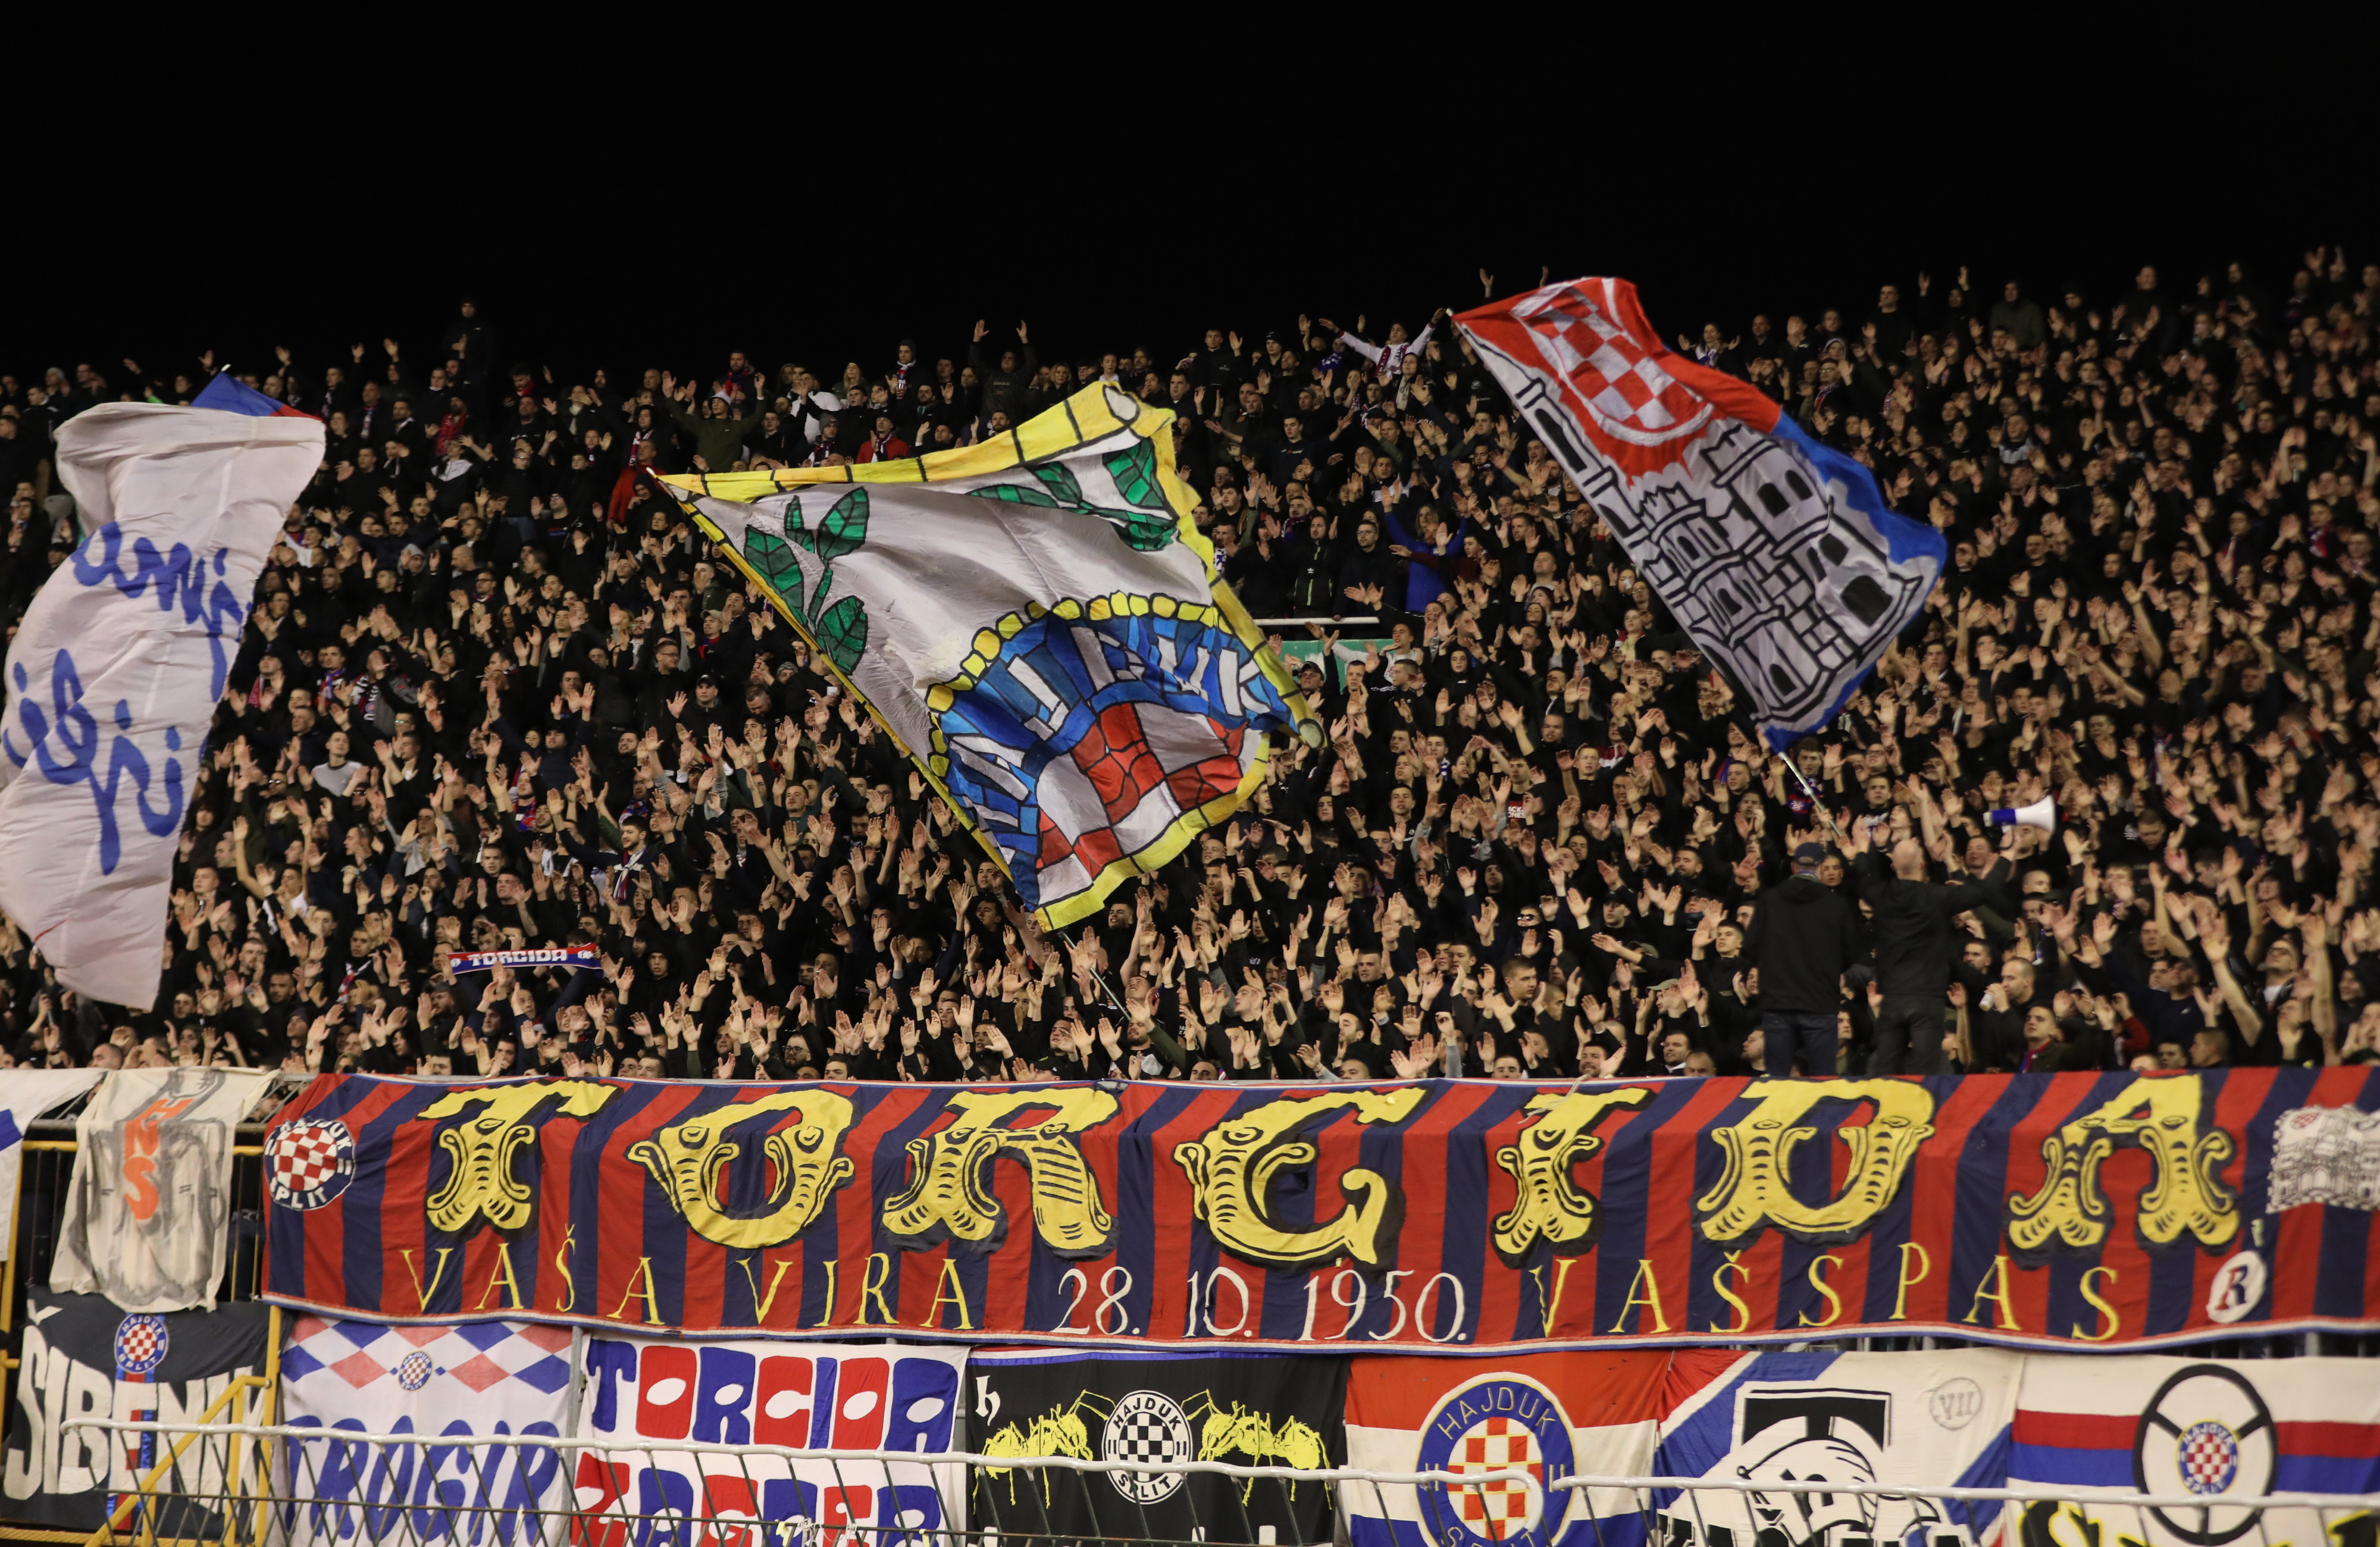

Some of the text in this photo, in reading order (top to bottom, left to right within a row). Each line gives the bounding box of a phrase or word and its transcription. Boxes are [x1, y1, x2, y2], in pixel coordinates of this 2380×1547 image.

[466, 949, 568, 967] TORCIDA
[400, 1223, 665, 1326] VAŠA
[735, 1252, 975, 1330] VIRA
[1050, 1266, 1141, 1336] 28.
[1299, 1269, 1468, 1343] 1950.
[121, 1316, 164, 1335] HAJDUK
[118, 1353, 156, 1371] SPLIT
[586, 1338, 959, 1454] TORCIDA
[1113, 1397, 1182, 1432] HAJDUK
[1437, 1386, 1557, 1440] HAJDUK
[2182, 1423, 2234, 1446] HAJDUK
